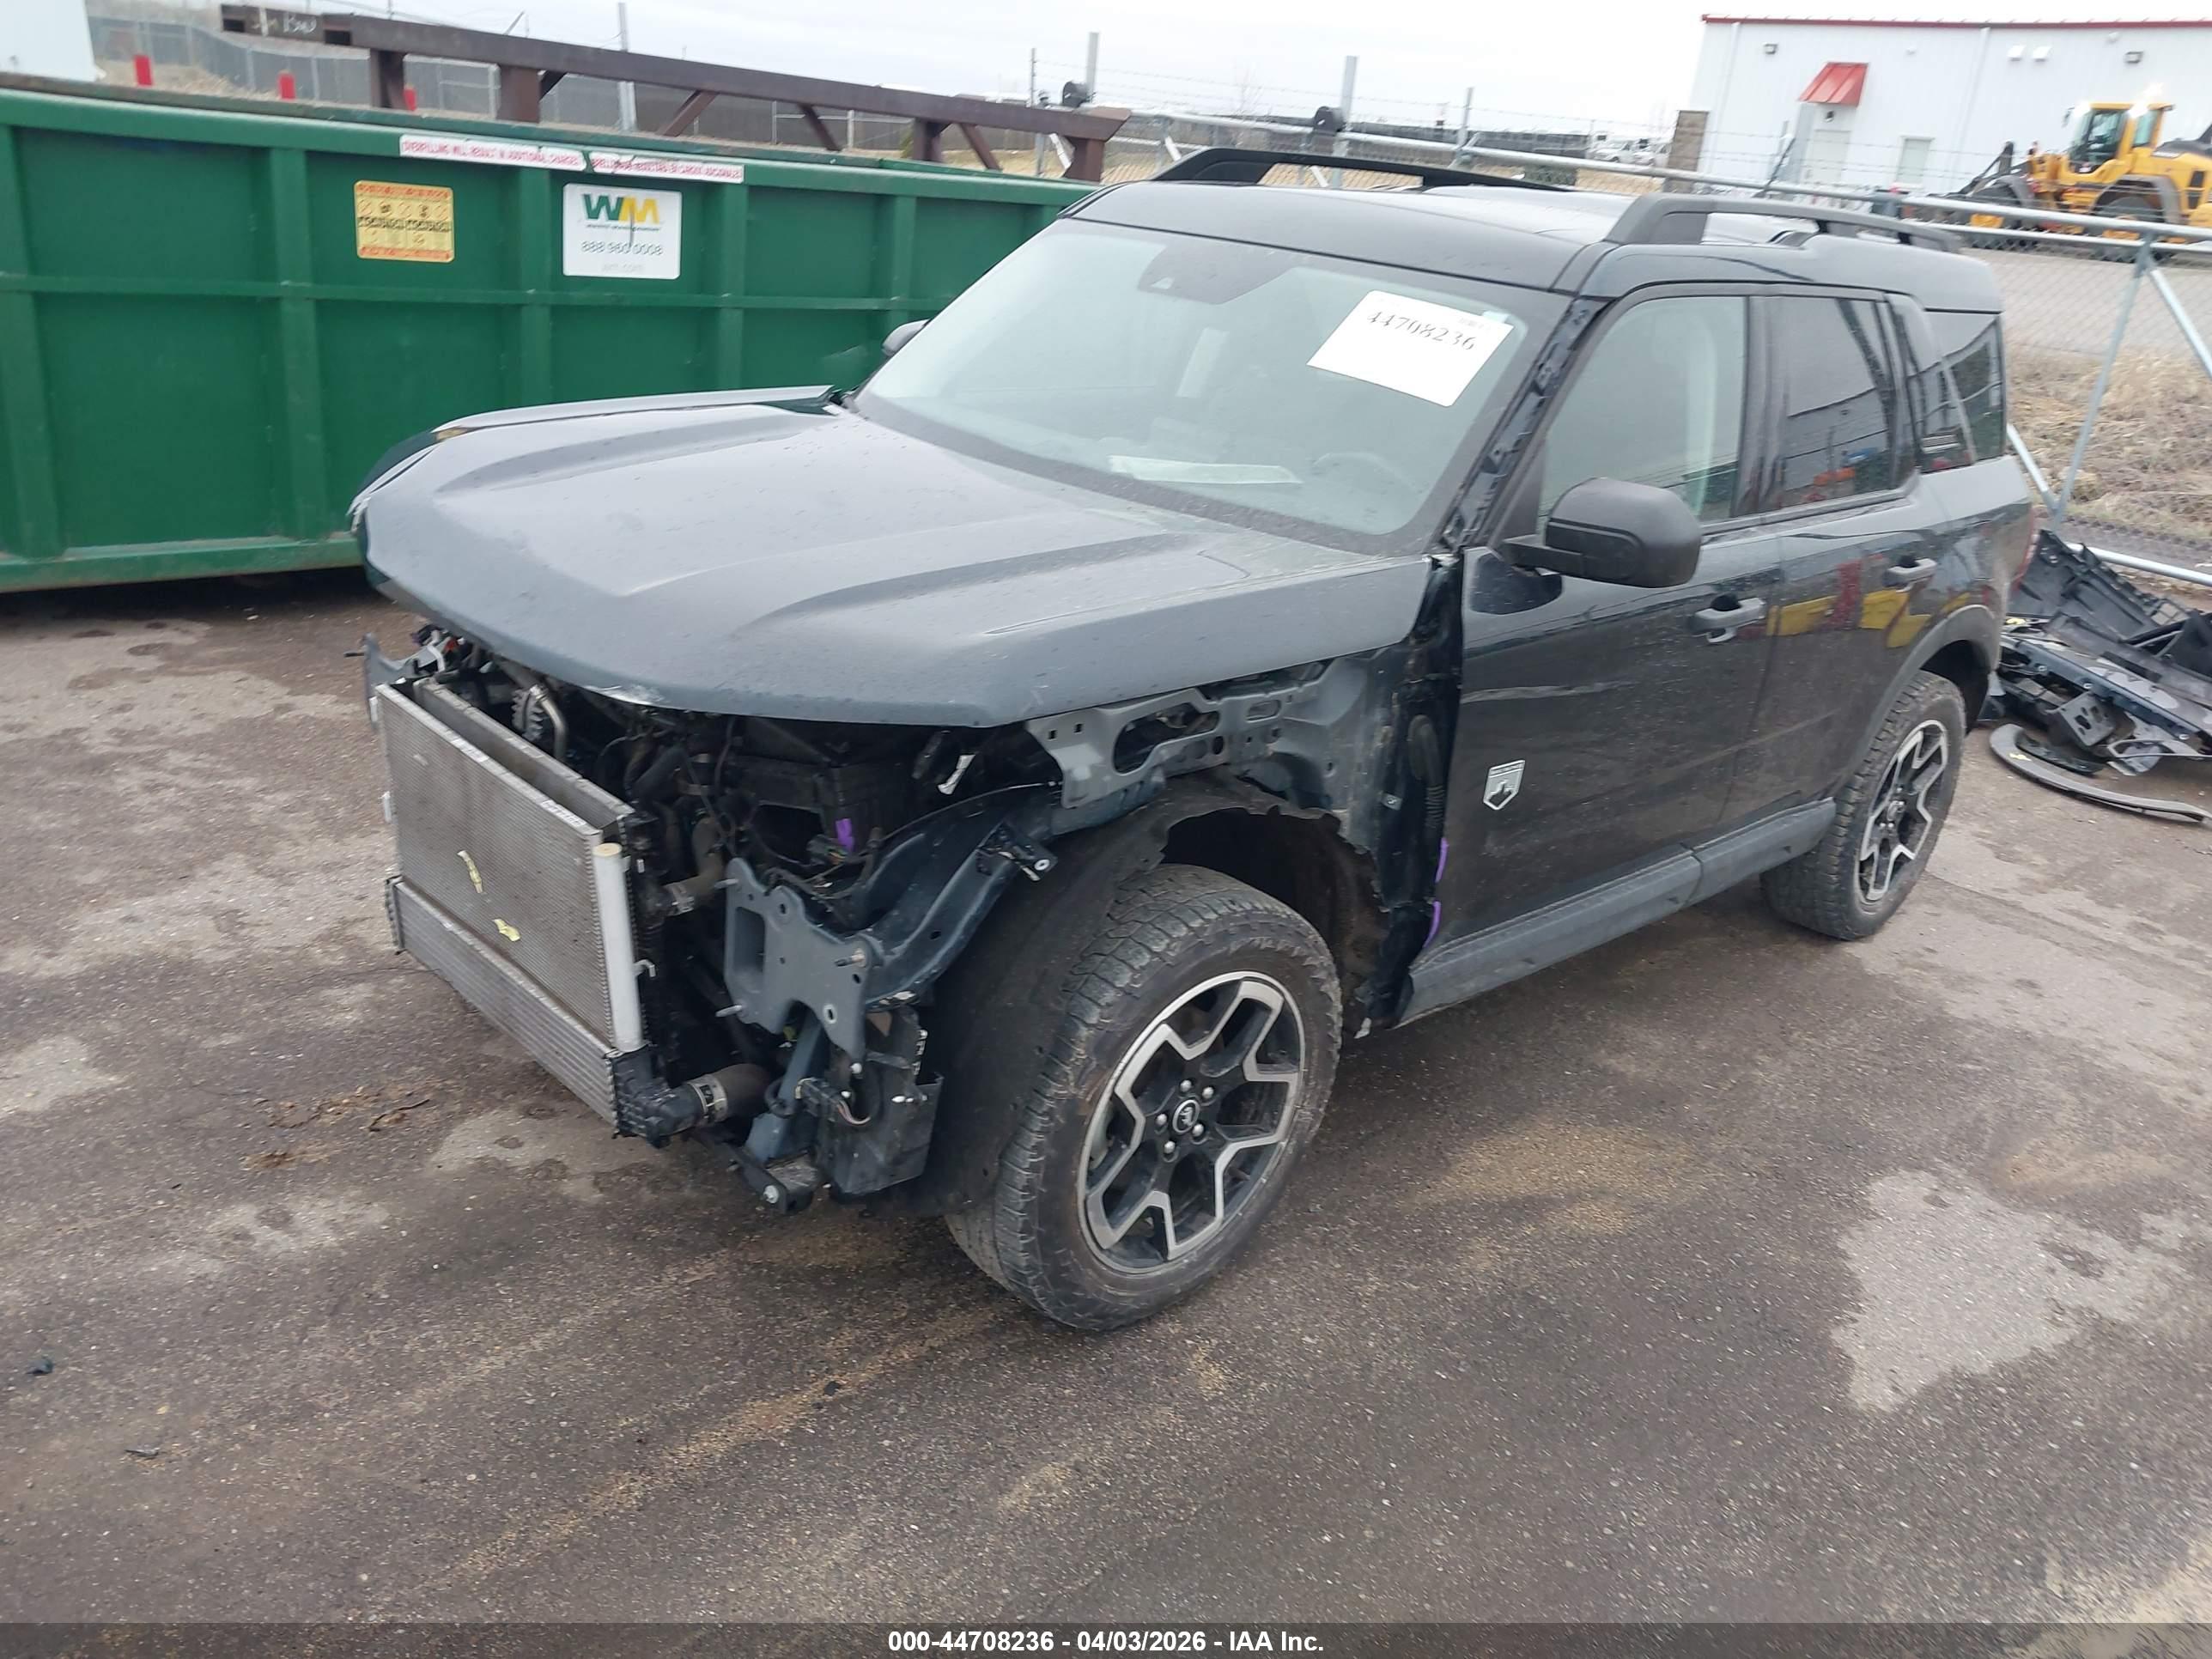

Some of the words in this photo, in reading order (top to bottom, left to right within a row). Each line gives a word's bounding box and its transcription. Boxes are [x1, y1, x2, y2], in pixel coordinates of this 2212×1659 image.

[582, 192, 660, 224] WM
[580, 240, 605, 253] 888
[1367, 311, 1476, 350] 44708236
